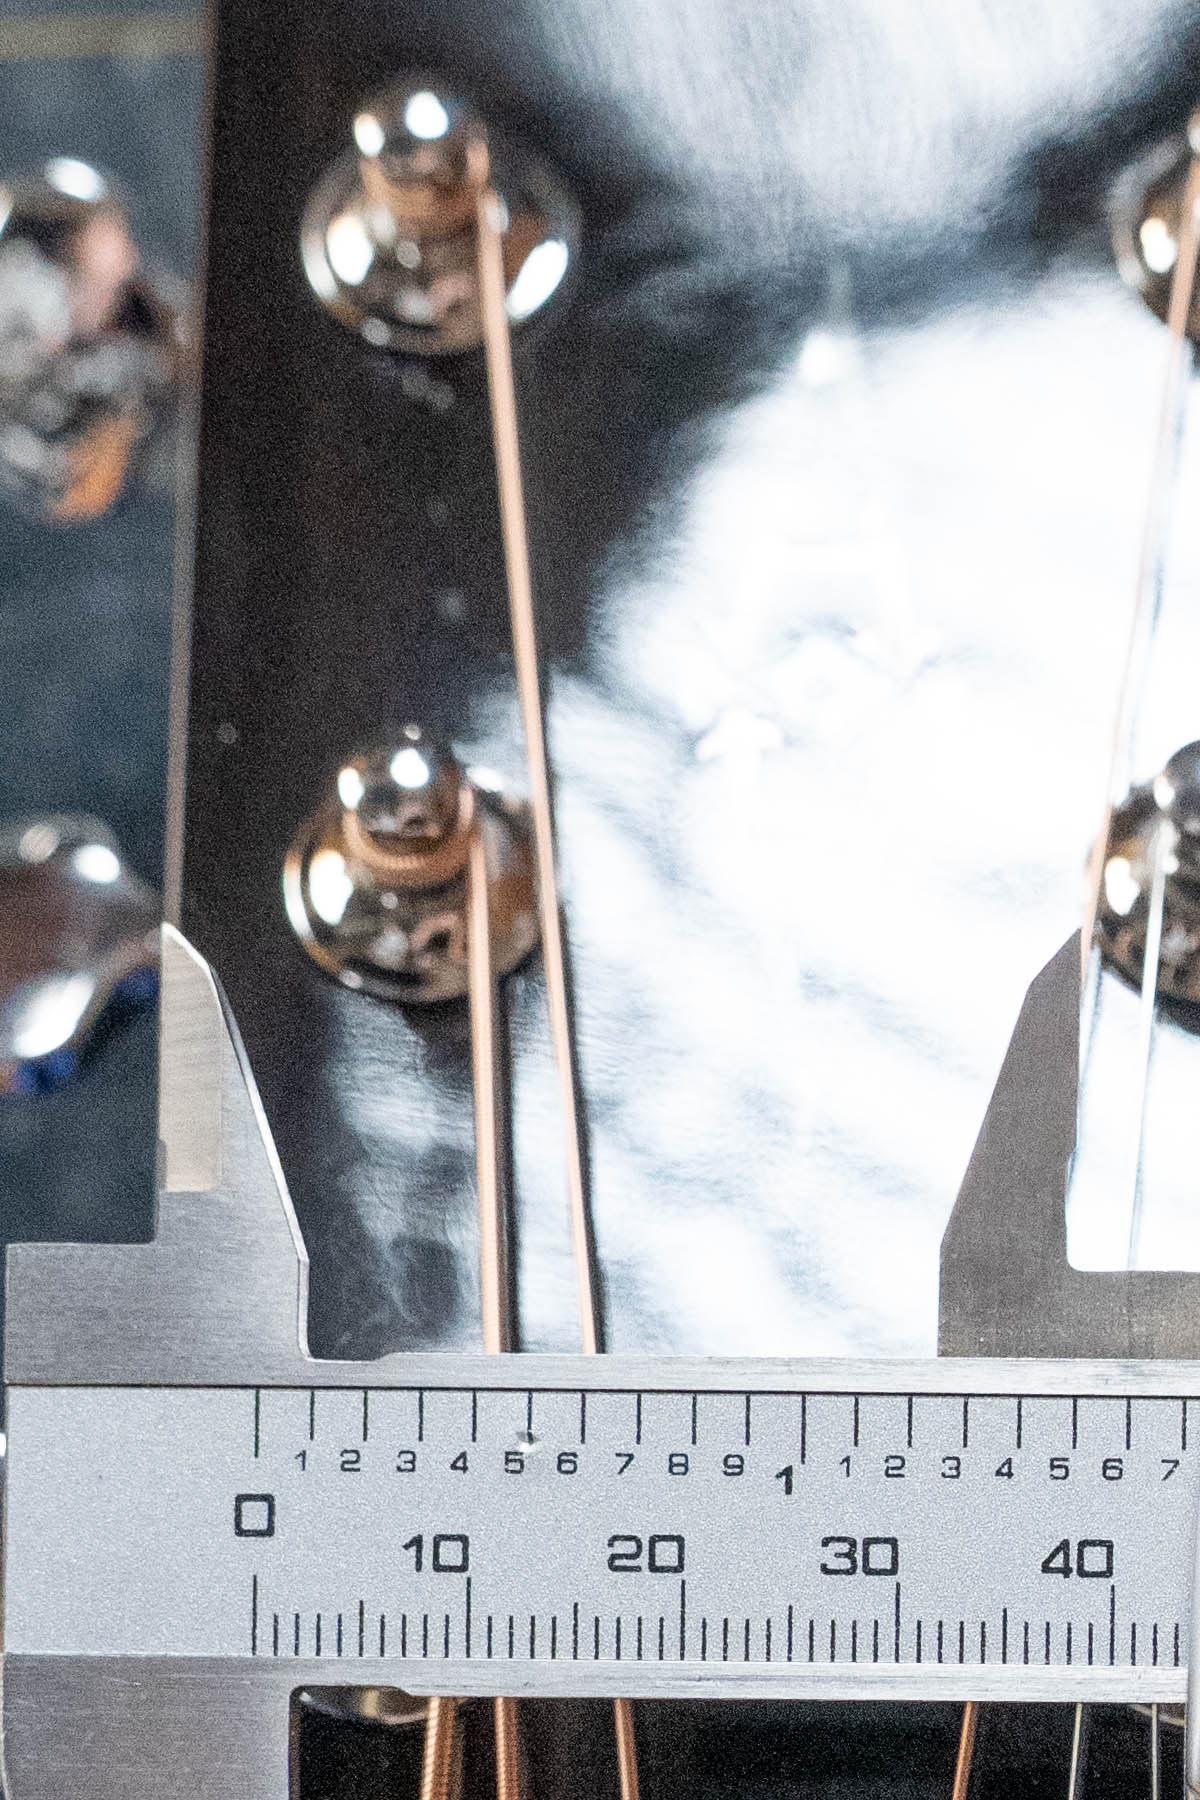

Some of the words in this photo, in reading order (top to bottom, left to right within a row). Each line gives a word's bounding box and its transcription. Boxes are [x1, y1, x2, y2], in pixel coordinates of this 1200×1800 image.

[296, 1450, 307, 1471] 1
[340, 1449, 361, 1473] 2
[396, 1449, 417, 1473] 3
[450, 1451, 469, 1474] 4
[504, 1450, 525, 1475] 5
[556, 1451, 578, 1475] 6
[615, 1452, 635, 1475] 7
[668, 1453, 690, 1476] 8
[722, 1453, 745, 1477] 9
[775, 1465, 794, 1496] 1
[840, 1455, 851, 1477] 1
[884, 1454, 906, 1479] 2
[941, 1456, 961, 1479] 3
[995, 1457, 1014, 1480] 4
[1049, 1457, 1070, 1481] 5
[1101, 1458, 1124, 1481] 6
[1161, 1459, 1180, 1481] 7
[233, 1493, 276, 1538] 0
[402, 1533, 470, 1574] 10
[607, 1534, 686, 1574] 20
[820, 1535, 899, 1577] 30
[1041, 1538, 1114, 1579] 40
